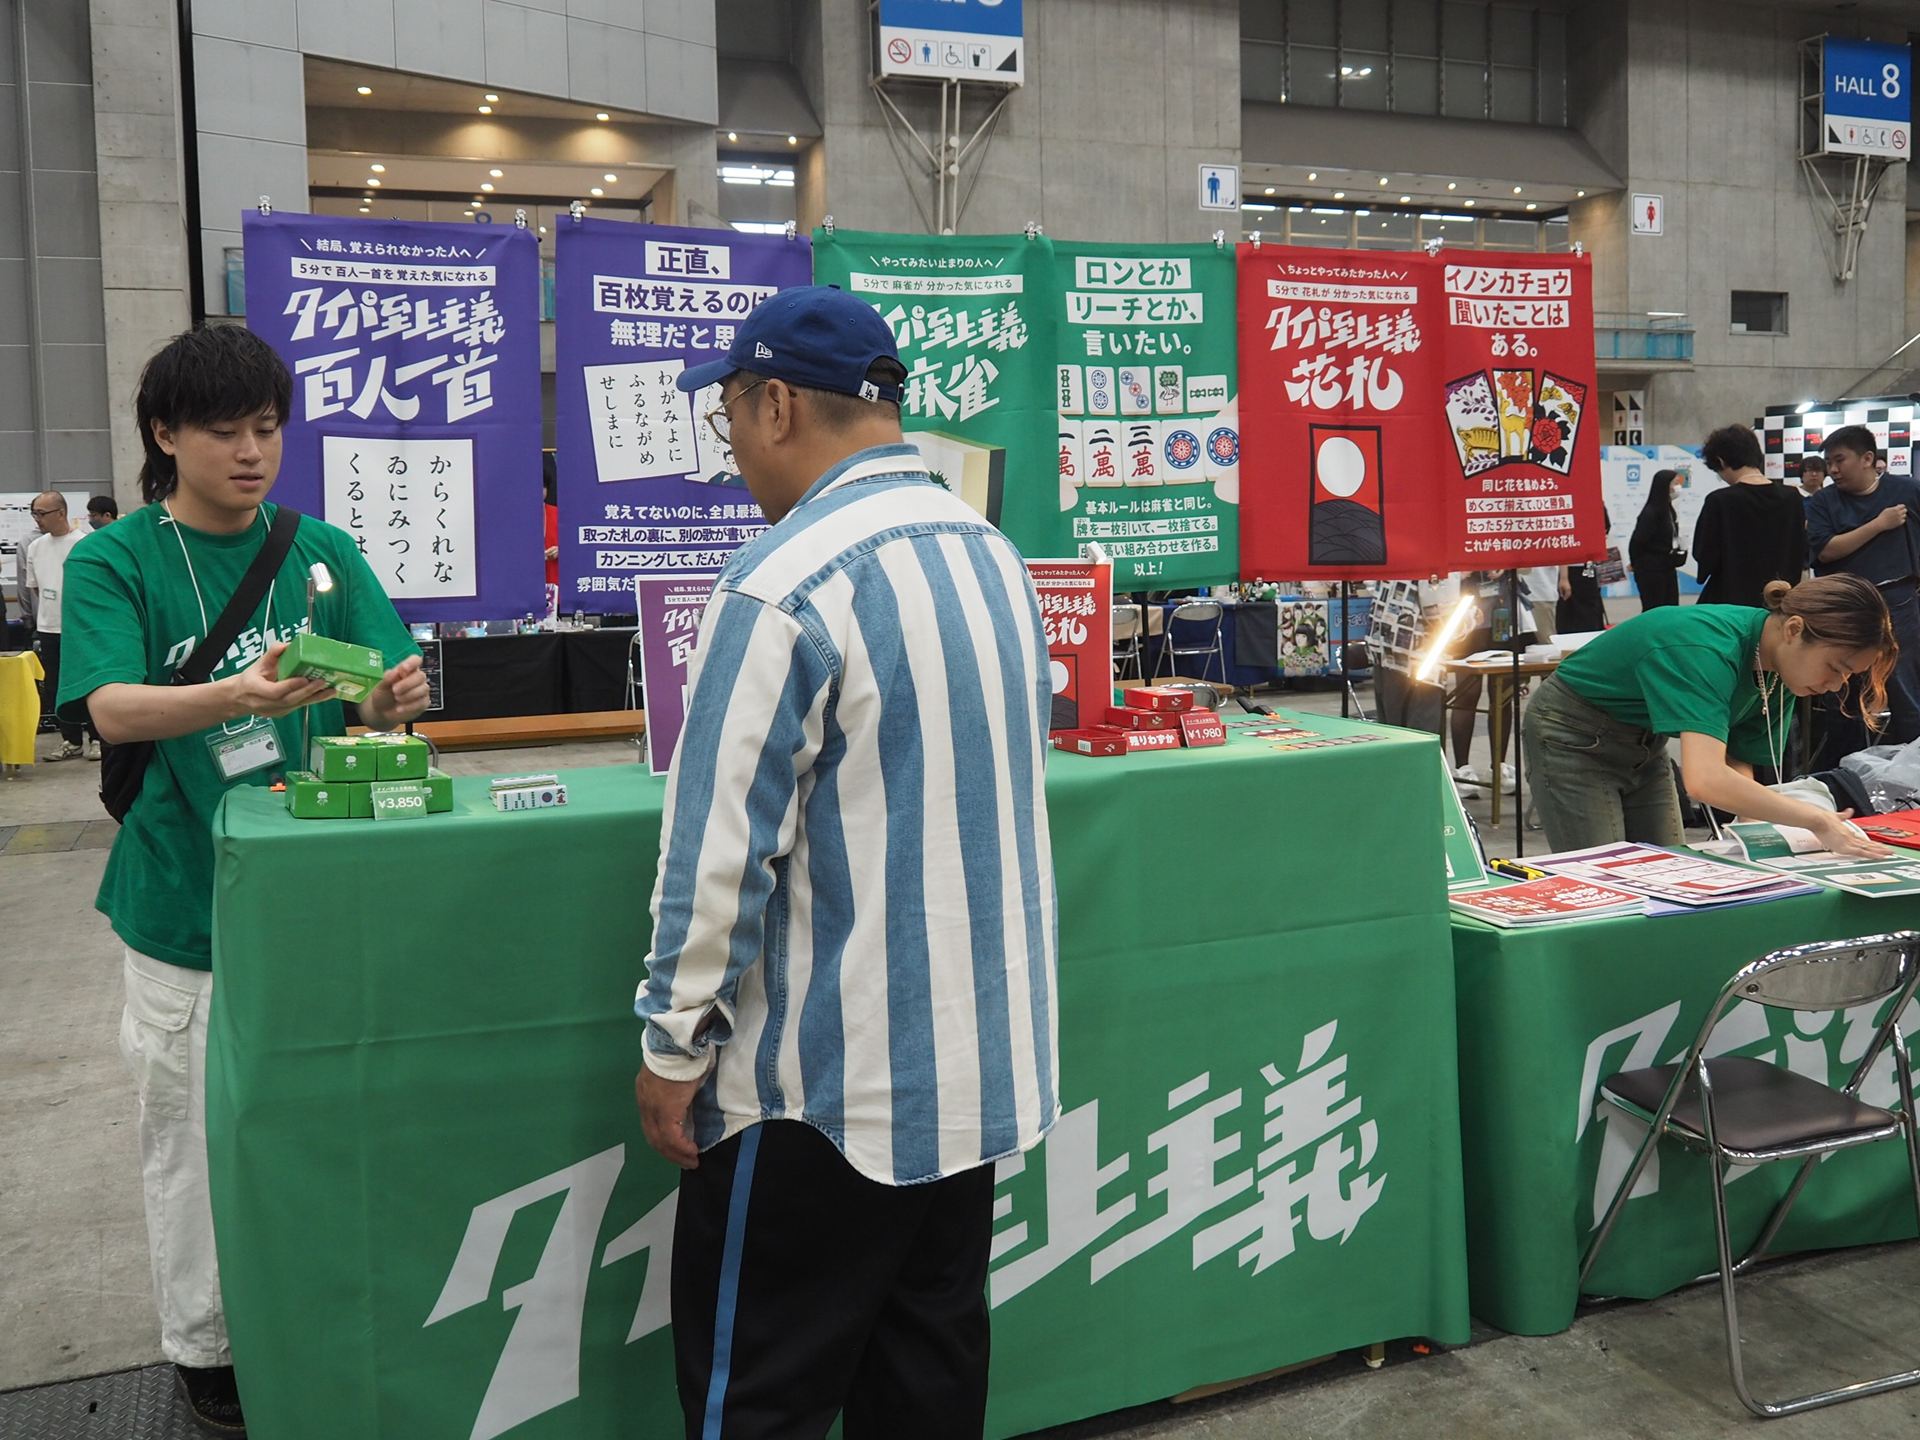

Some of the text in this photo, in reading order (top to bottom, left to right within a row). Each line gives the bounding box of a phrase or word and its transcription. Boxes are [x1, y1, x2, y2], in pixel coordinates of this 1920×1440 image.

[1835, 63, 1900, 98] HALL 8
[300, 263, 488, 282] 5分で 百人一首を 覚えた気になれる
[657, 246, 721, 275] 正直、
[881, 256, 993, 268] やってみたい止まりの人へ
[1086, 260, 1182, 285] ロンとか
[1287, 264, 1400, 279] ちょっとやってみたかった人へ
[863, 278, 1012, 291] 5分で 麻雀が 分かった気になれる
[1275, 285, 1410, 300] 5分で 花札が 分かった気になれる
[1446, 268, 1569, 294] イノシカチョウ
[283, 287, 505, 345] タイパ至上主義
[1075, 296, 1197, 322] リーチとか、
[1456, 300, 1564, 326] 聞いたことは
[1082, 330, 1191, 356] 言いたい。
[1264, 305, 1422, 355] タイパ至上主義
[1491, 333, 1538, 357] ある。
[294, 347, 499, 423] 百人一首
[1283, 353, 1404, 411] 花札
[600, 375, 623, 449] せしまに
[629, 374, 655, 465] ふるながめ
[658, 370, 682, 462] わがみよに
[1482, 478, 1558, 492] 同じ花を集めよう。
[1085, 496, 1212, 515] 基本ルールは麻雀と同じ。
[388, 456, 410, 584] ゐにみつく
[430, 456, 454, 583] からくれな
[1469, 517, 1572, 531] たった5分で大体わかる。
[1134, 561, 1163, 576] 以上!
[1129, 733, 1174, 746] 残りわずか
[1187, 727, 1222, 740] ¥1,980
[378, 796, 422, 809] ¥3,850
